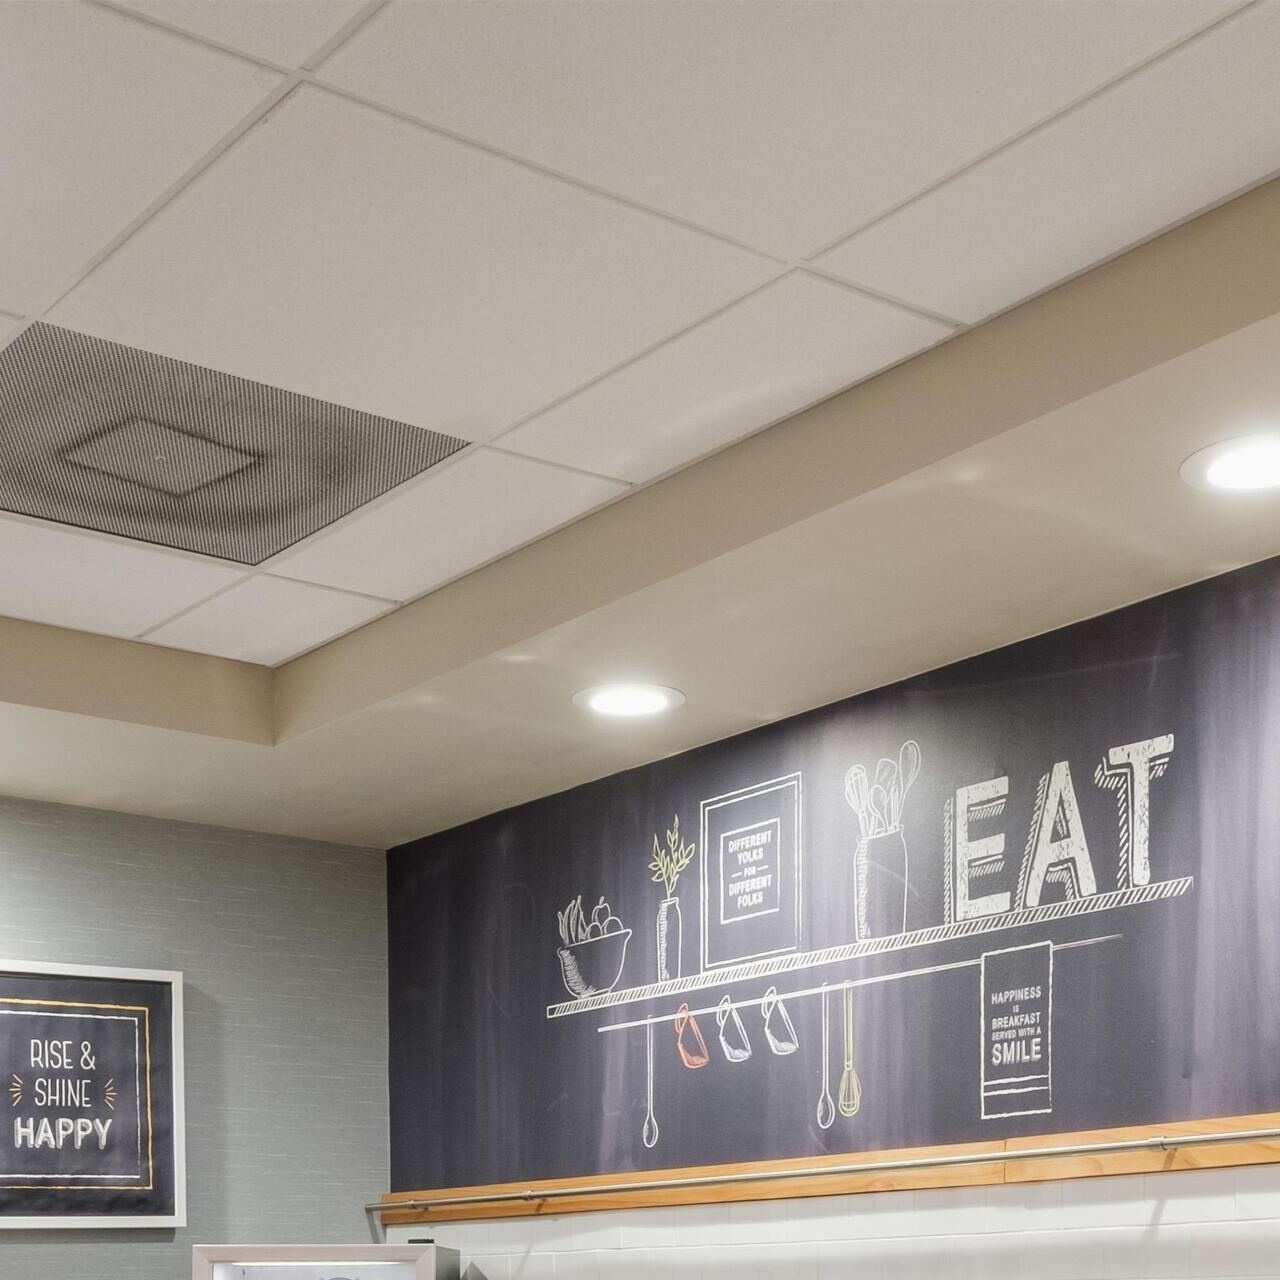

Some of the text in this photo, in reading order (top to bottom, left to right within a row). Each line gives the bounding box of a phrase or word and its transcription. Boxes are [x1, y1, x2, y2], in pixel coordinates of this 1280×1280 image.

[944, 733, 1174, 924] EAT
[728, 830, 772, 854] DIFFERENT
[737, 847, 763, 865] YOLKS
[729, 874, 772, 896] DIFFERENT
[738, 891, 763, 909] FOLKS
[991, 986, 1041, 1005] HAPPINESS
[1013, 1005, 1019, 1013] IS
[992, 1012, 1041, 1030] BREAKFAST
[992, 1026, 1041, 1041] SERVED WITH A
[30, 1039, 96, 1070] RISE &
[992, 1038, 1041, 1066] SMILE
[34, 1077, 92, 1107] SHINE
[14, 1117, 113, 1149] HAPPY
